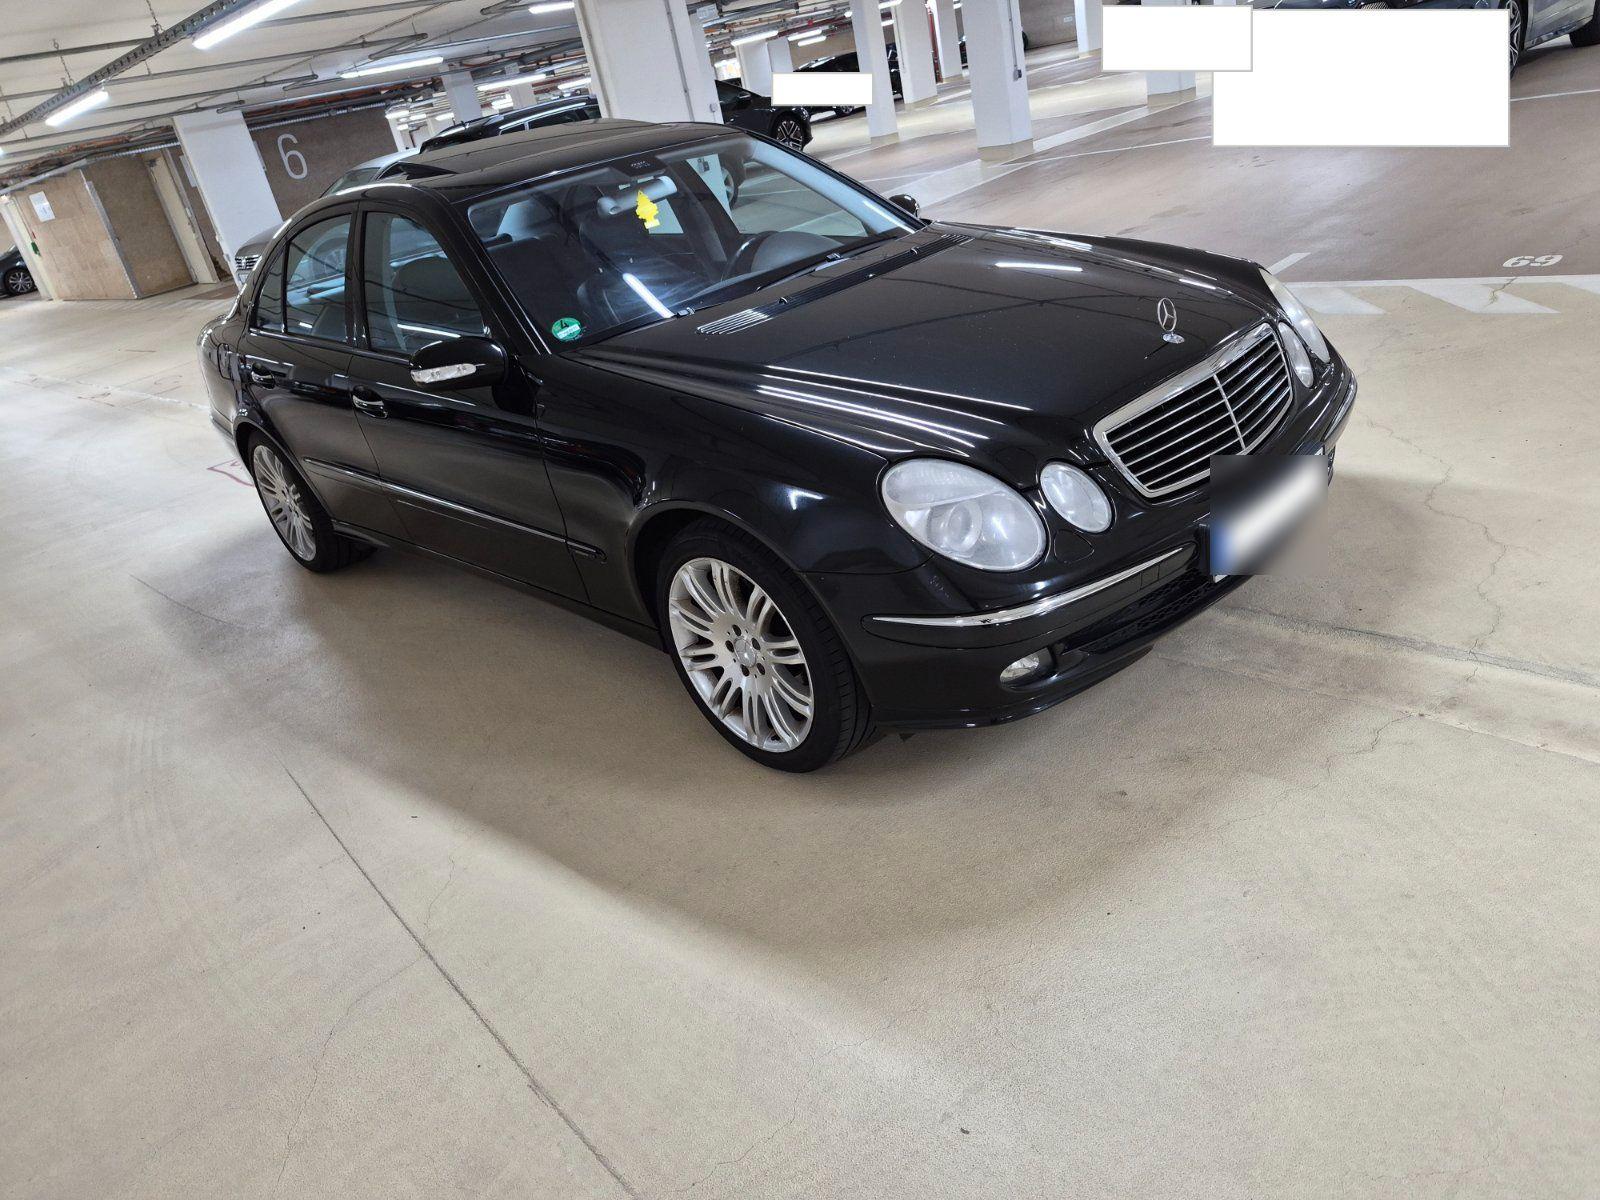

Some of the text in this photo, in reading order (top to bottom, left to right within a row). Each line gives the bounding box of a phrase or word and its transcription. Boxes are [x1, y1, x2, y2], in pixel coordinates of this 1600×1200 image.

[278, 134, 308, 179] 6
[1503, 254, 1563, 268] 69
[560, 319, 570, 329] 4
